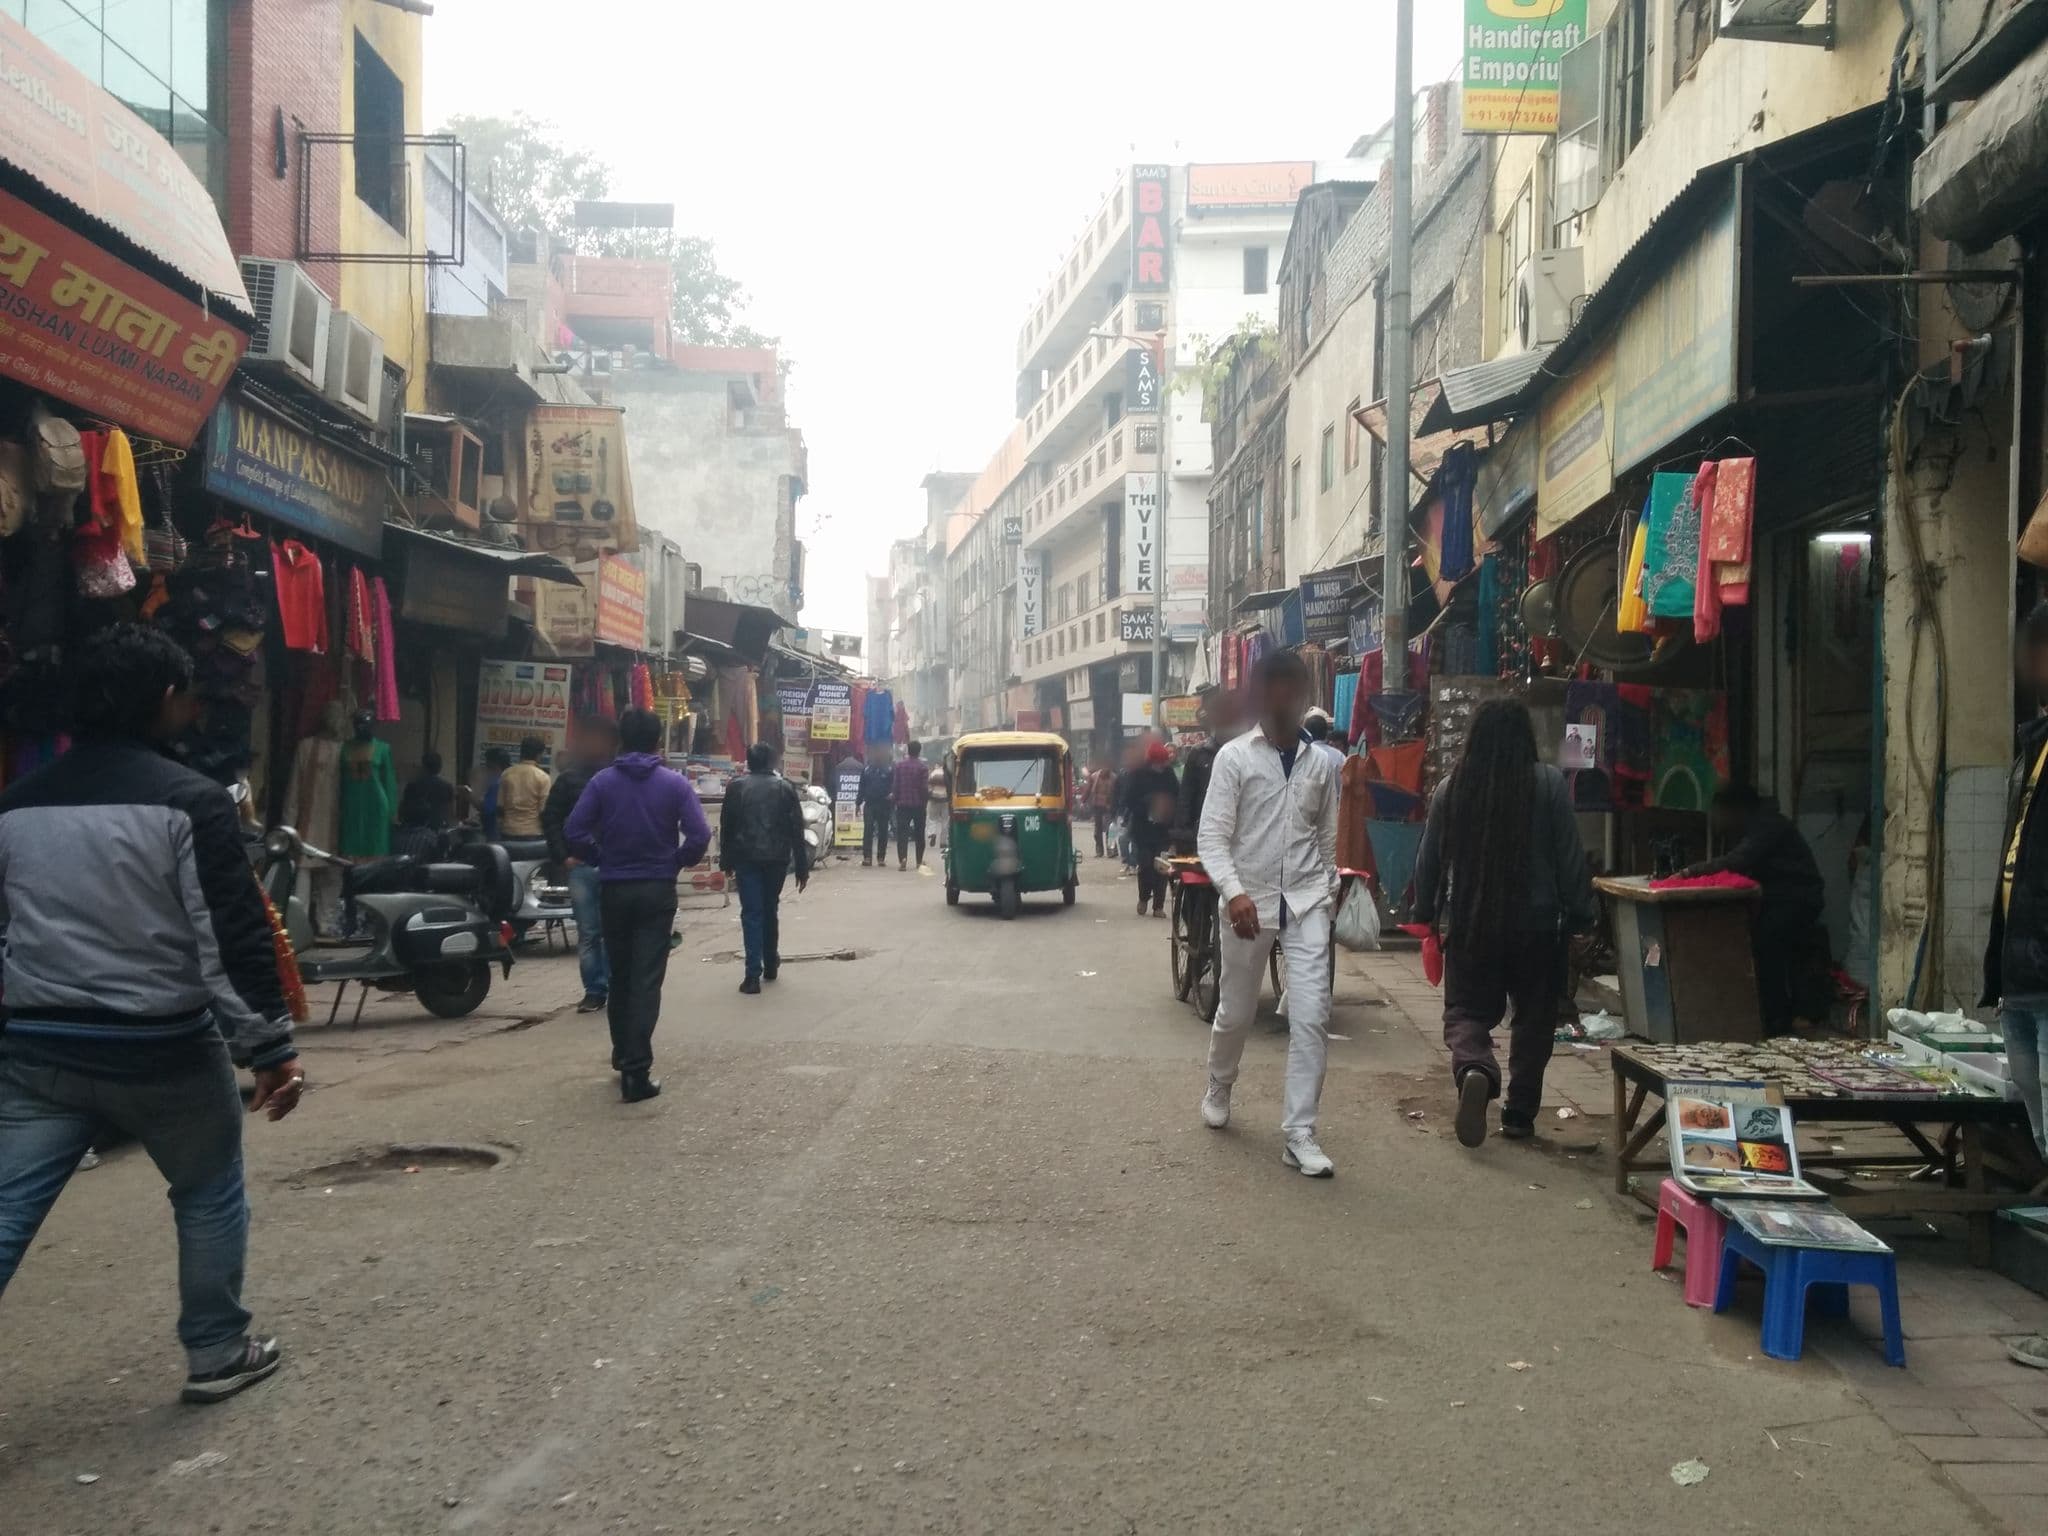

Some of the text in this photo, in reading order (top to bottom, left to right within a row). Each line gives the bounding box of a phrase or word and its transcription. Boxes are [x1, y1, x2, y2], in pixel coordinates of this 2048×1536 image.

[1468, 23, 1580, 48] Handicraft
[1468, 56, 1559, 87] Emporiu
[1135, 167, 1167, 178] SAM'S
[1137, 182, 1165, 284] BAR
[51, 260, 183, 358] माता
[182, 328, 240, 387] दी
[79, 326, 141, 372] LUXMI
[142, 359, 205, 402] NARAIN
[1137, 352, 1156, 405] SAM'S
[235, 406, 366, 505] MANPASAND
[1137, 508, 1153, 591] VIVEK
[1020, 566, 1041, 576] THE
[1313, 581, 1341, 598] MANISH
[1024, 577, 1036, 637] VIVEK
[1123, 626, 1154, 640] BAR
[479, 677, 566, 709] INDIA
[814, 697, 850, 705] EXCHANGER
[817, 683, 849, 692] FOREIGN
[840, 783, 860, 792] MON
[1024, 815, 1041, 832] CNG
